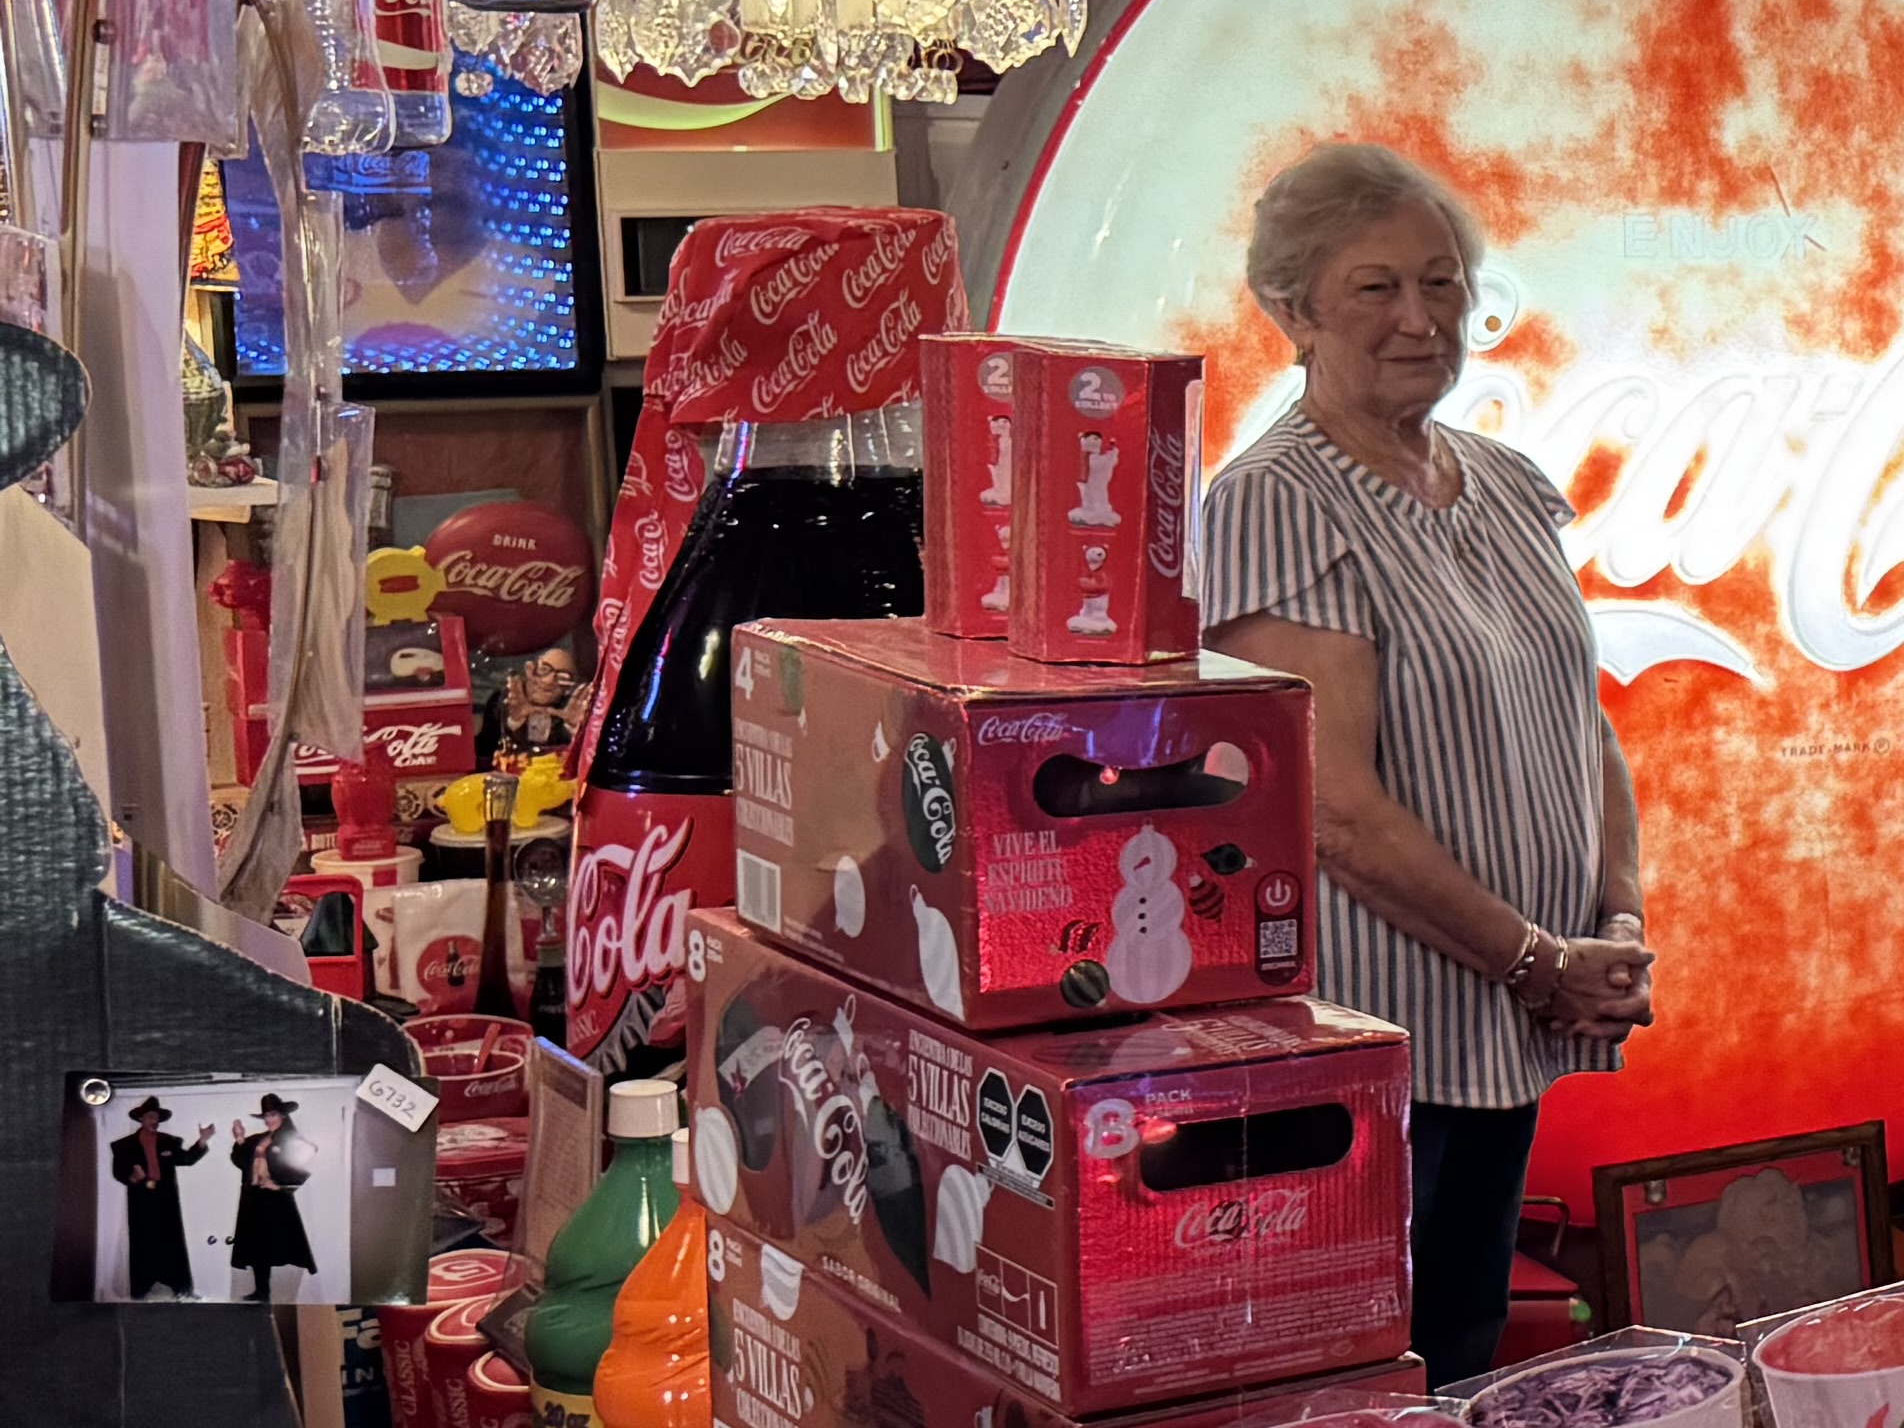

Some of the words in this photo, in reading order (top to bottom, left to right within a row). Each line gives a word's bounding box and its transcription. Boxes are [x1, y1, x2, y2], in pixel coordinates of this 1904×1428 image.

[1623, 215, 1818, 260] ENJOY
[752, 322, 838, 413] Coca-Cola
[847, 298, 922, 392] Coca-Cola
[987, 360, 1009, 383] 2
[1080, 372, 1101, 398] 2
[493, 534, 536, 550] DRINK
[736, 647, 754, 700] 4
[993, 832, 1035, 856] VIVE
[1039, 831, 1061, 854] EL
[688, 930, 706, 983] 8
[908, 1056, 917, 1101] 5
[919, 1064, 972, 1128] VILLAS
[1084, 1099, 1141, 1159] 8
[1145, 1089, 1192, 1105] PACK
[708, 1229, 726, 1282] 8
[734, 1327, 744, 1380] 5
[747, 1335, 801, 1420] VILLAS
